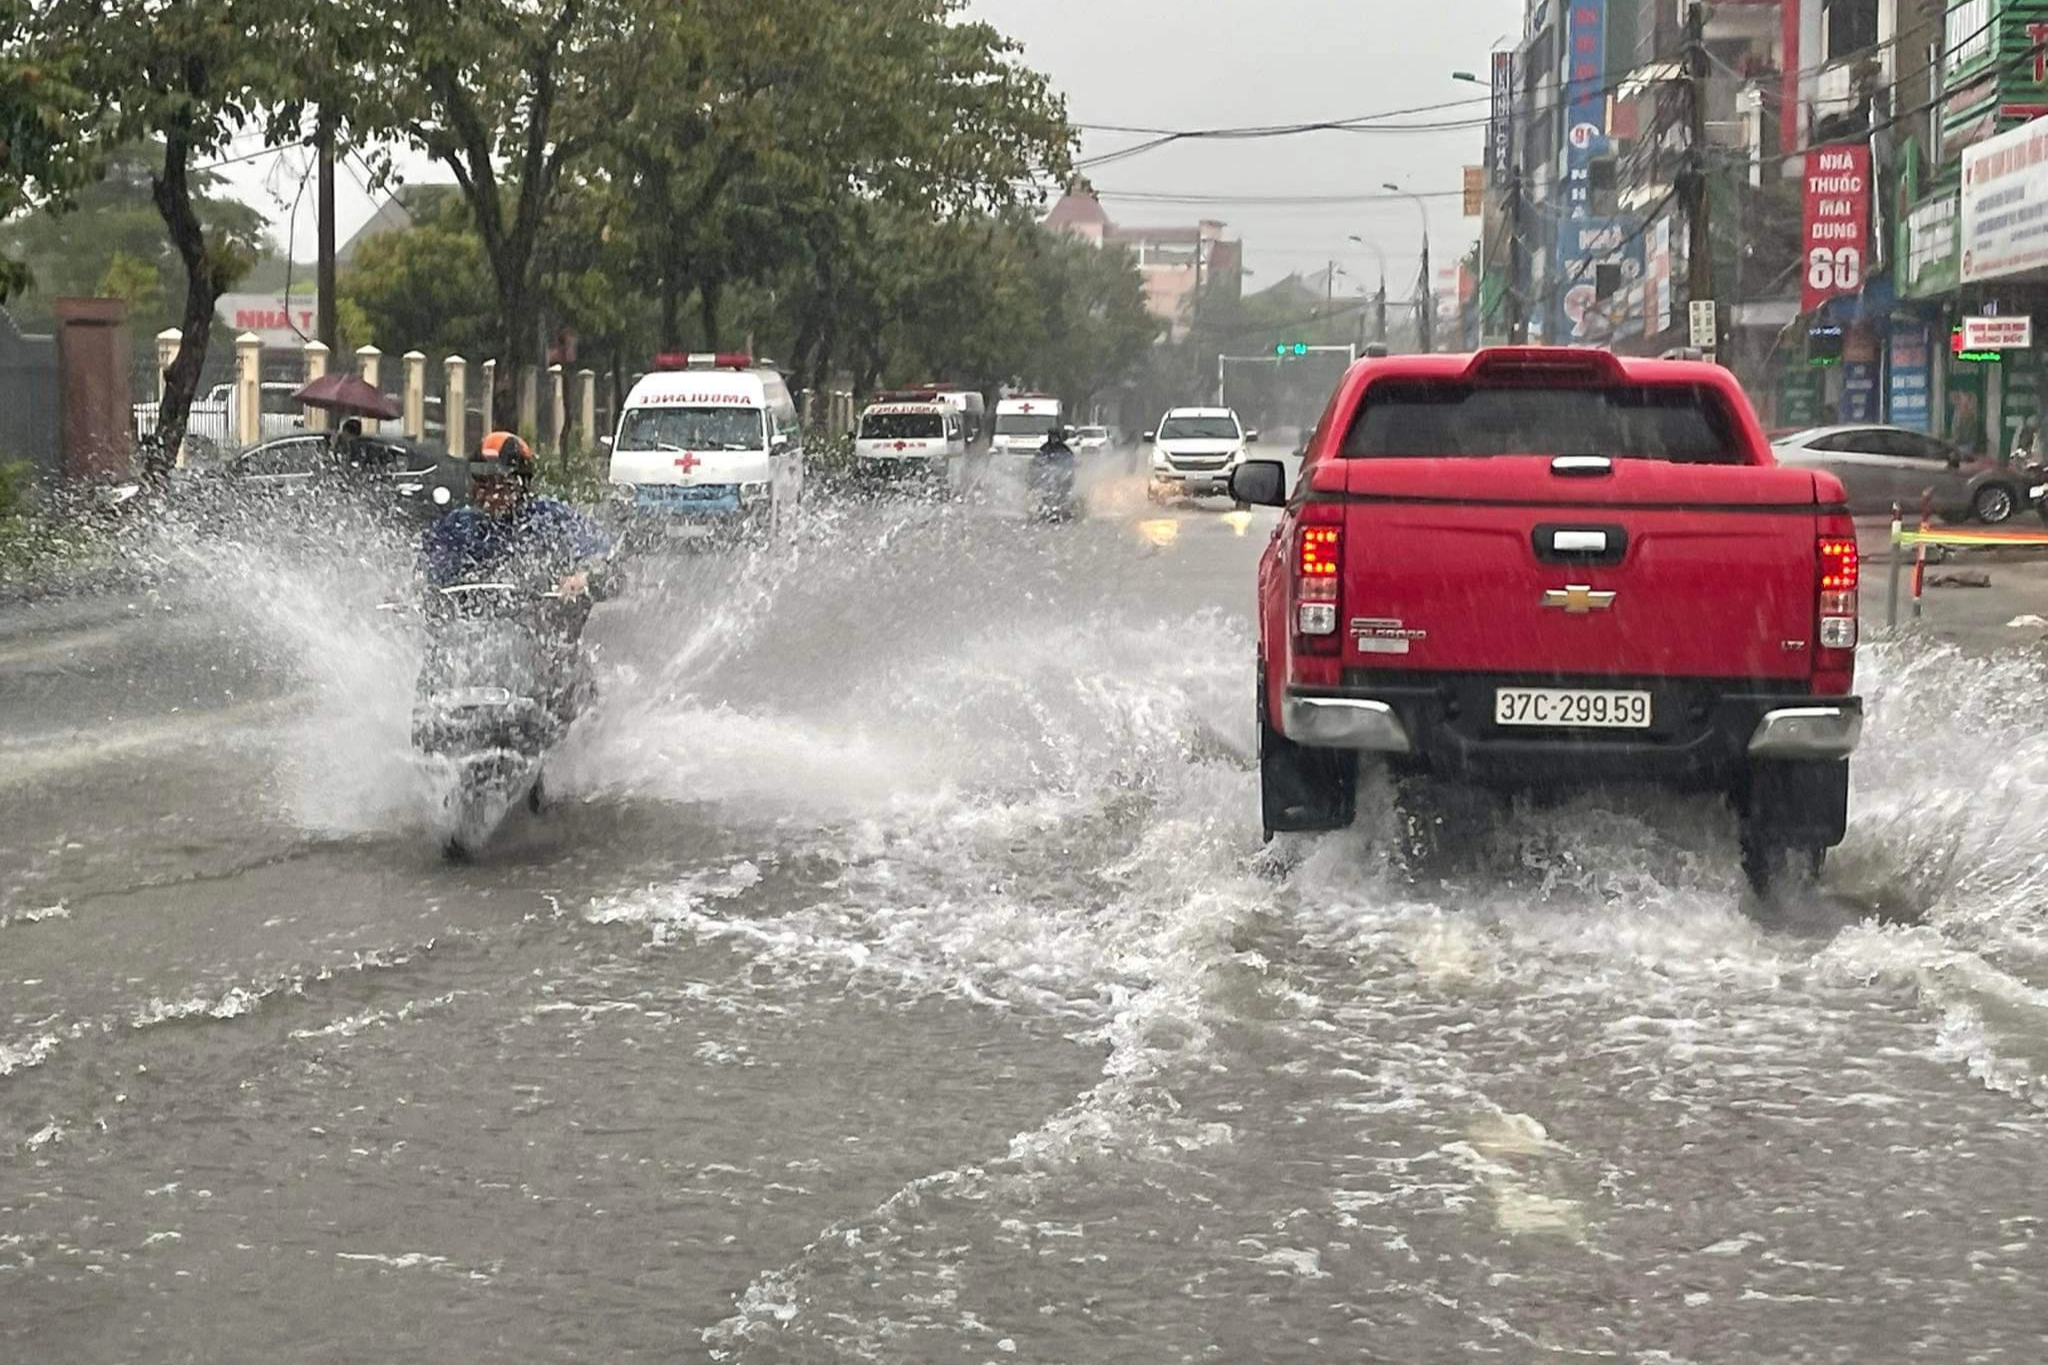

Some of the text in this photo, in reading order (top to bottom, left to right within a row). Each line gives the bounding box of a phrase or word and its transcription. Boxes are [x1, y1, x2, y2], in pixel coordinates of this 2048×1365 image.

[1820, 150, 1854, 170] NHÀ
[1809, 172, 1861, 193] THUỐC
[1819, 200, 1851, 216] MAI
[1500, 693, 1646, 724] 37C-299.59
